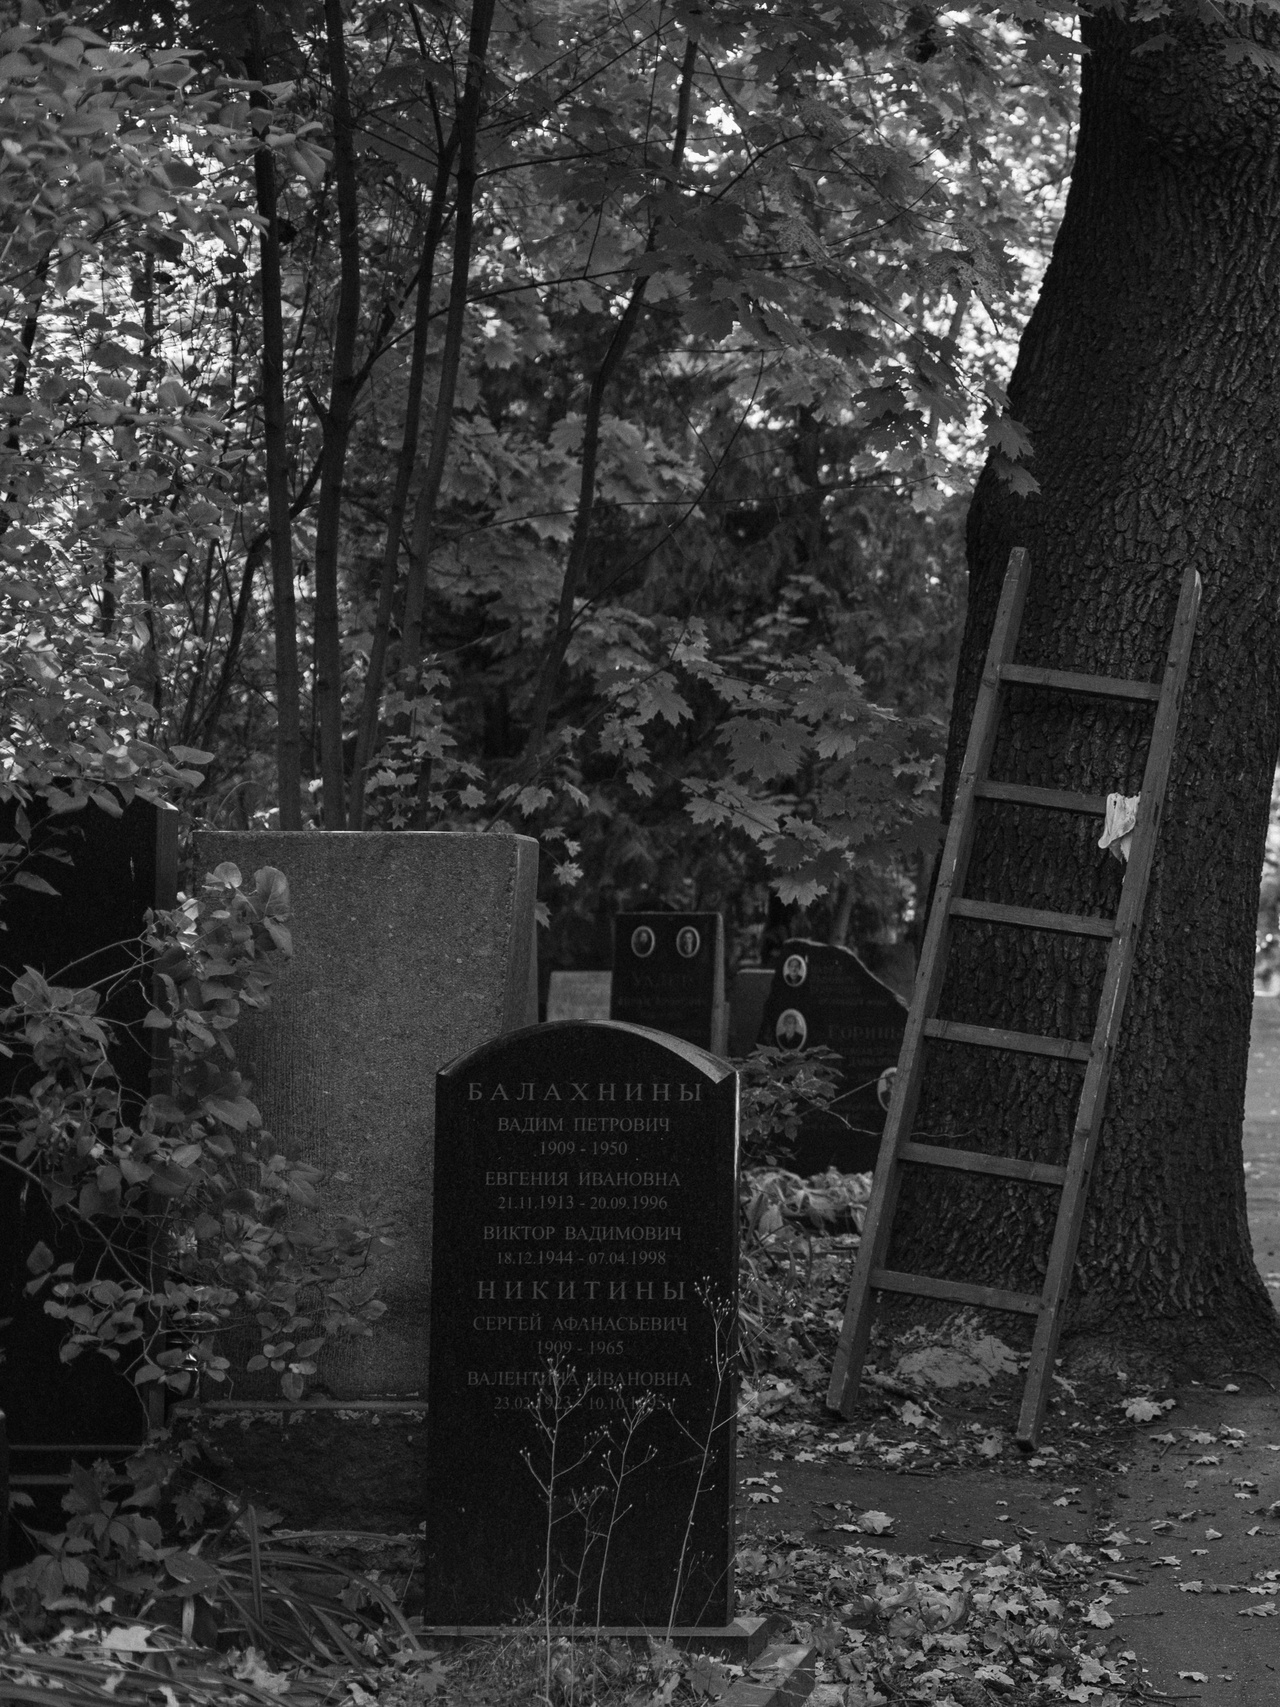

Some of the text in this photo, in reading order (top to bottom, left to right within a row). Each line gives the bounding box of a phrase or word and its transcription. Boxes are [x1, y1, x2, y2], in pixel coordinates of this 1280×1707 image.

[468, 1082, 702, 1102] БАЛАХНИНЫ
[497, 1117, 671, 1134] ВАДИМ ПЕТРОВИЧ
[540, 1141, 575, 1156] 1909
[592, 1140, 628, 1156] 1950
[485, 1171, 681, 1187] ЕВГЕНИЯ ИВАНОВНА
[497, 1196, 575, 1210] 21.11.1913
[590, 1196, 668, 1210] 20.09.1996
[483, 1226, 682, 1243] ВИКТОР ВАДИМОВИЧ
[497, 1250, 574, 1265] 18.12.1944
[588, 1250, 666, 1265] 07.04.1998
[477, 1280, 687, 1300] НИКИТИНЫ
[472, 1313, 688, 1332] СЕРГЕЙ АФАНАСЬЕВИЧ
[536, 1340, 573, 1355] 1909
[589, 1340, 624, 1355] 1965
[467, 1371, 692, 1387] ВАЛЕНТИНА ИВАНОВНА
[588, 1395, 666, 1411] 10.10.195
